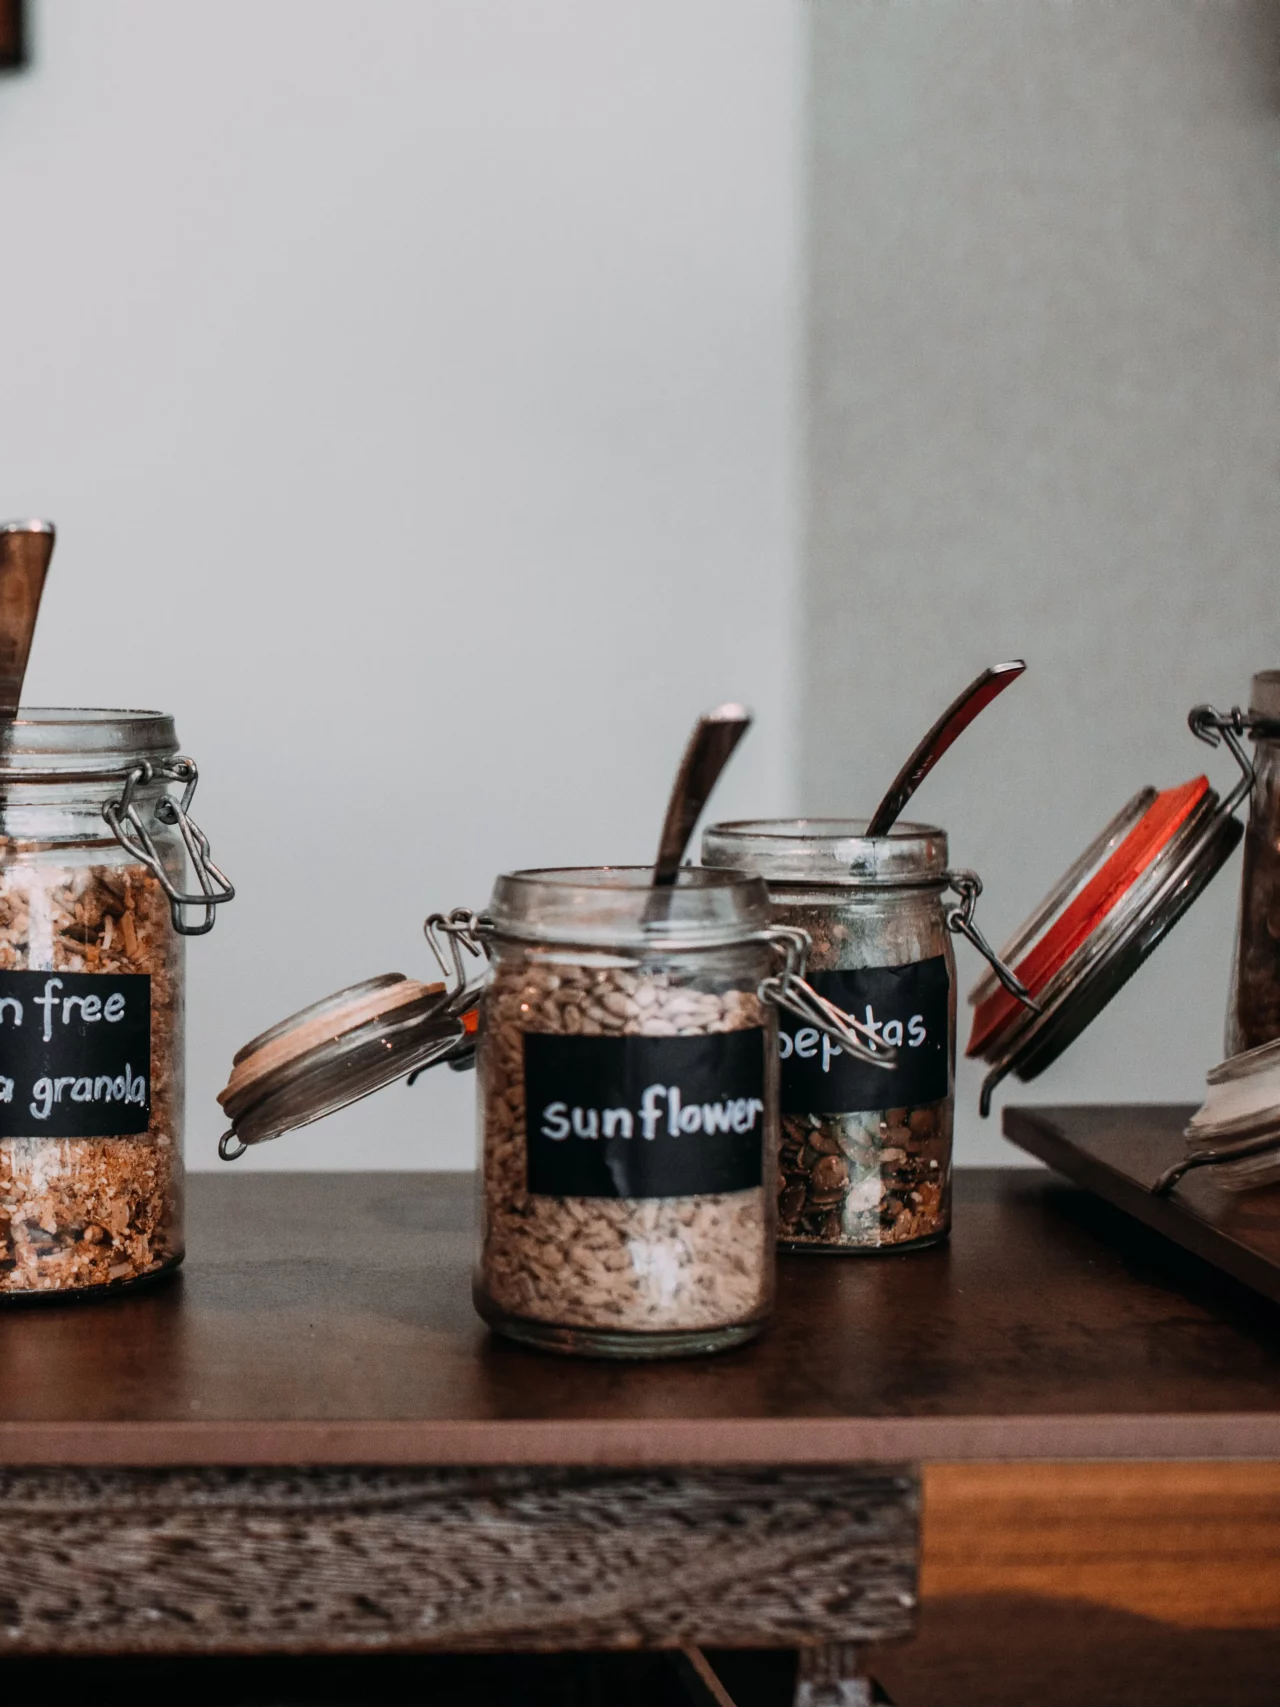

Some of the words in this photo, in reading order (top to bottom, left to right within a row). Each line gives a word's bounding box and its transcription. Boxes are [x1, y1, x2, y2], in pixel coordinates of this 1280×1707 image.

[33, 977, 126, 1043] free
[29, 1062, 147, 1120] granola
[541, 1083, 764, 1141] sunflower
